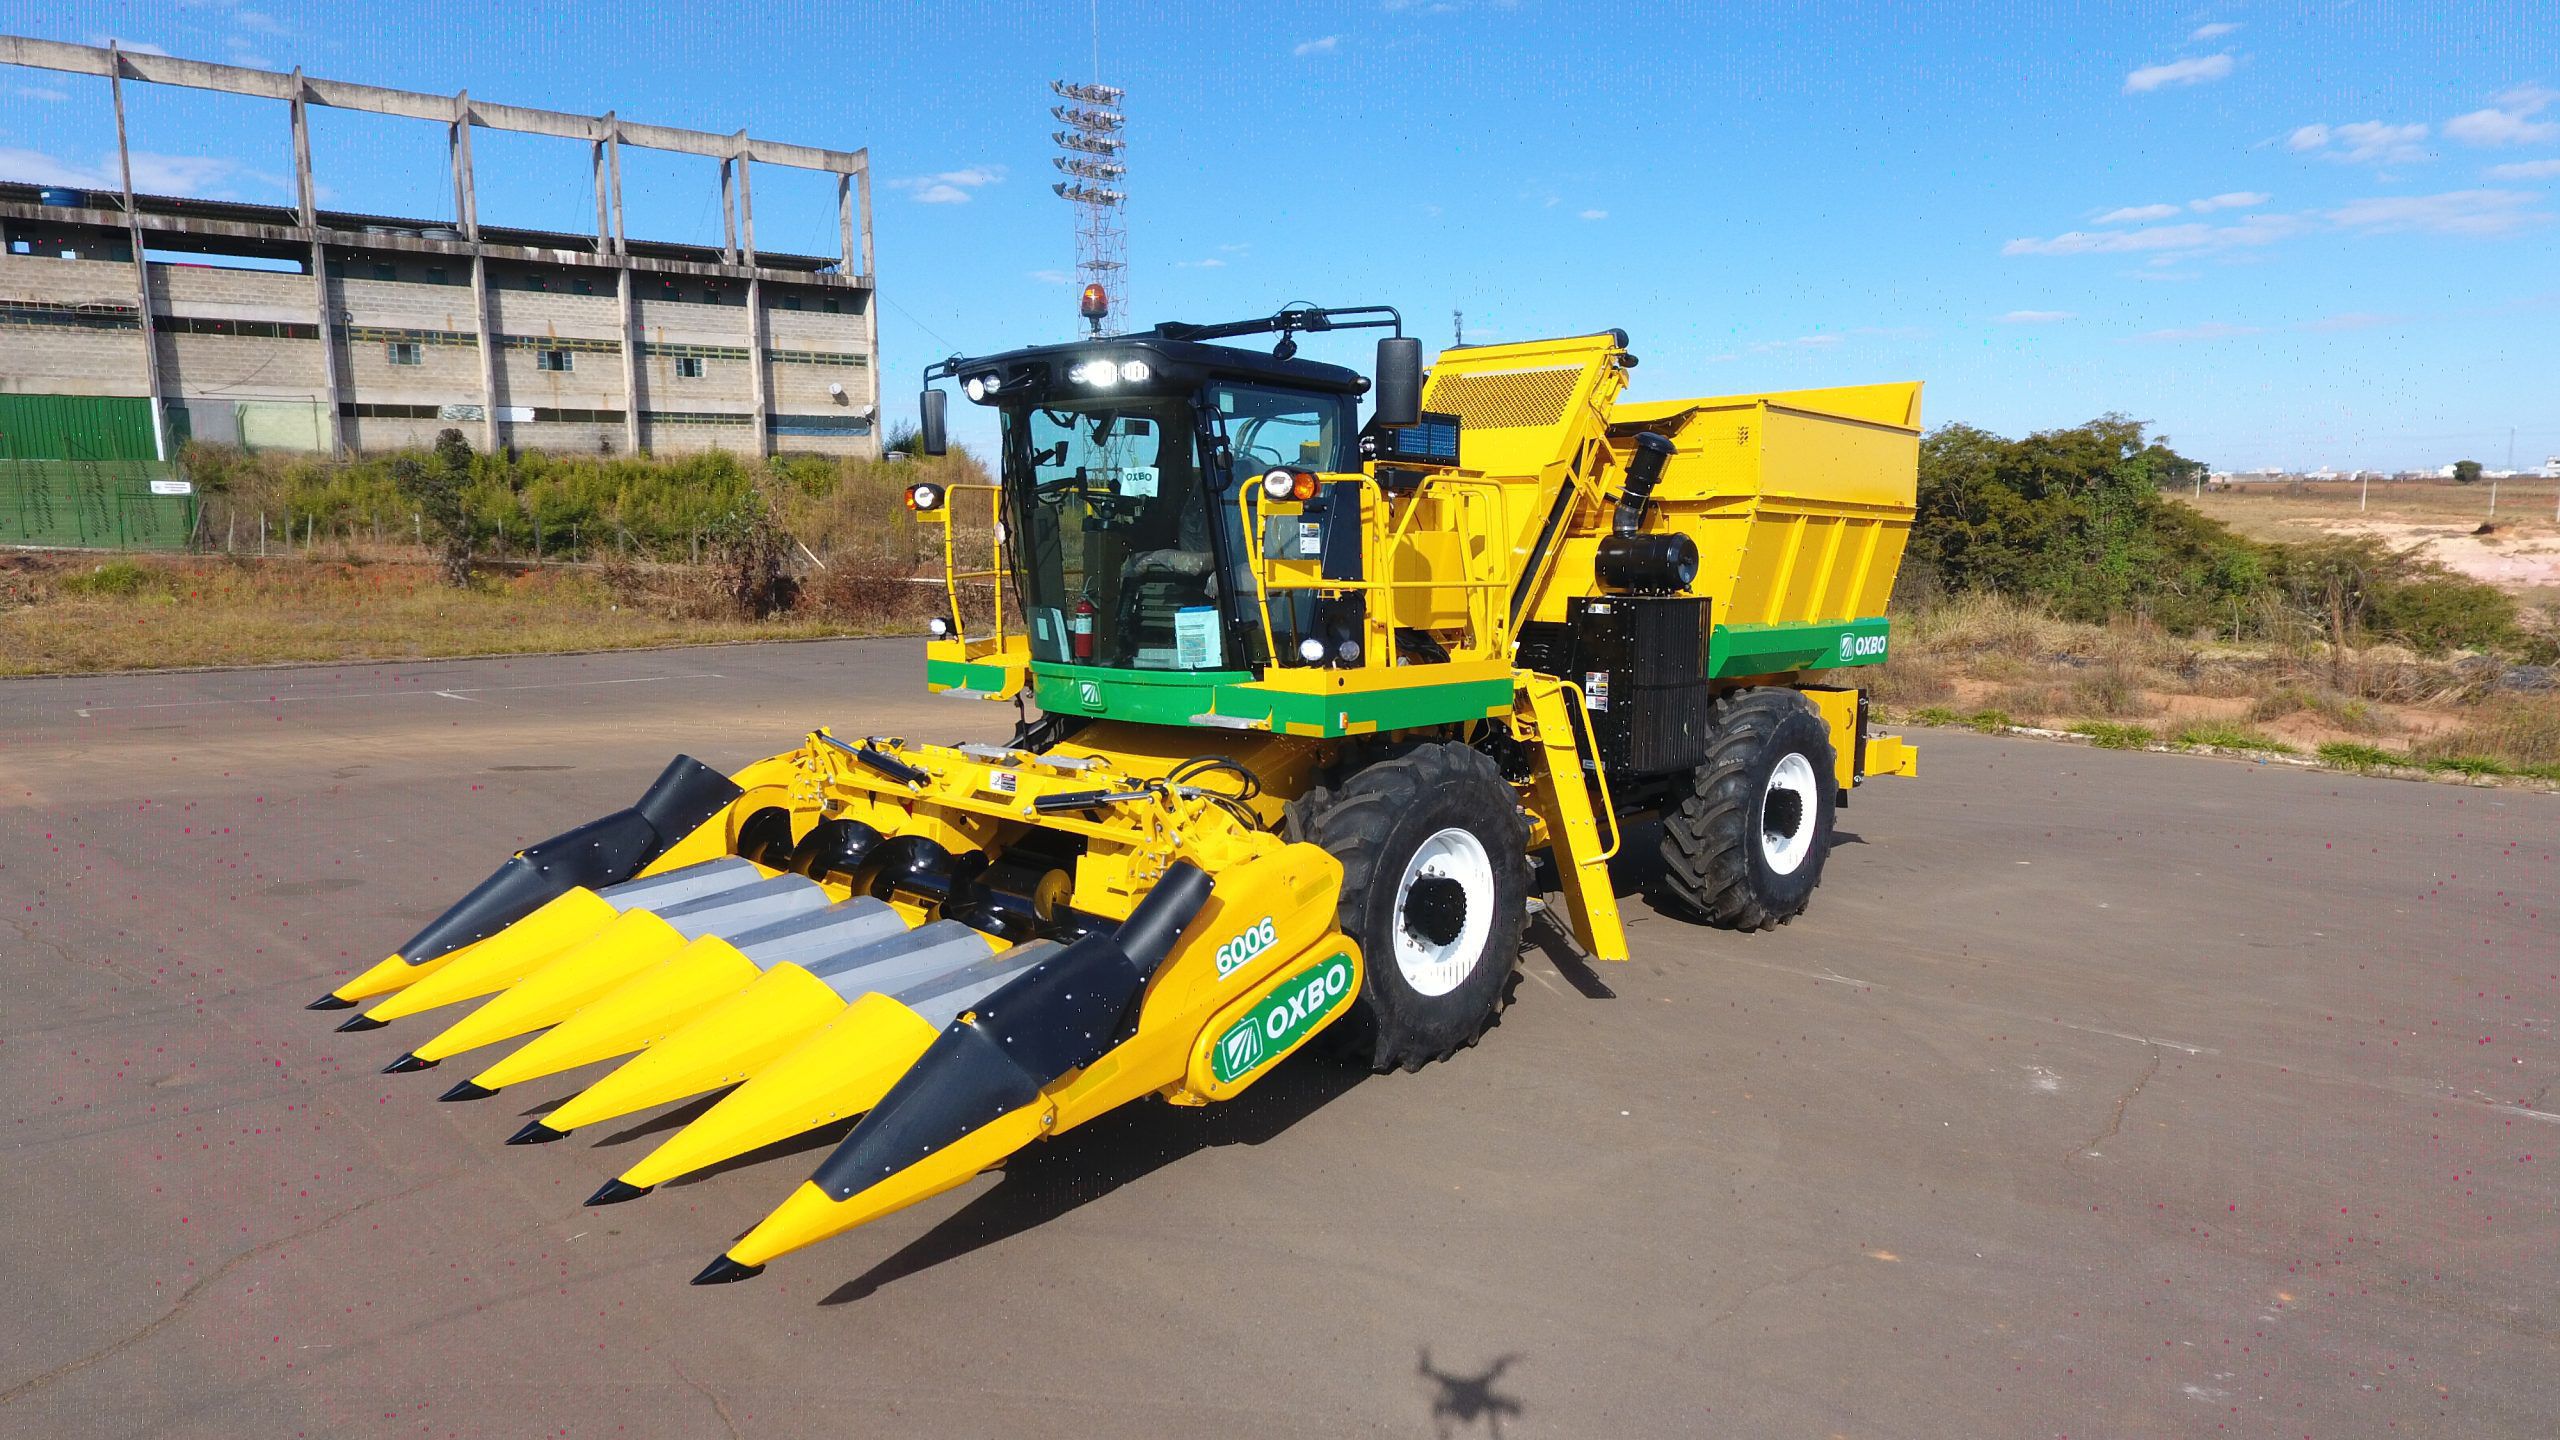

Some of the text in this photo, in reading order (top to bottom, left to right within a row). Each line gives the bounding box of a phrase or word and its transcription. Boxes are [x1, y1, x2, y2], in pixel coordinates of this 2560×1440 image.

[1126, 472, 1152, 481] OXBO
[1855, 635, 1886, 656] OXBO
[1216, 916, 1275, 974] 6006
[1266, 963, 1346, 1039] OXBO
